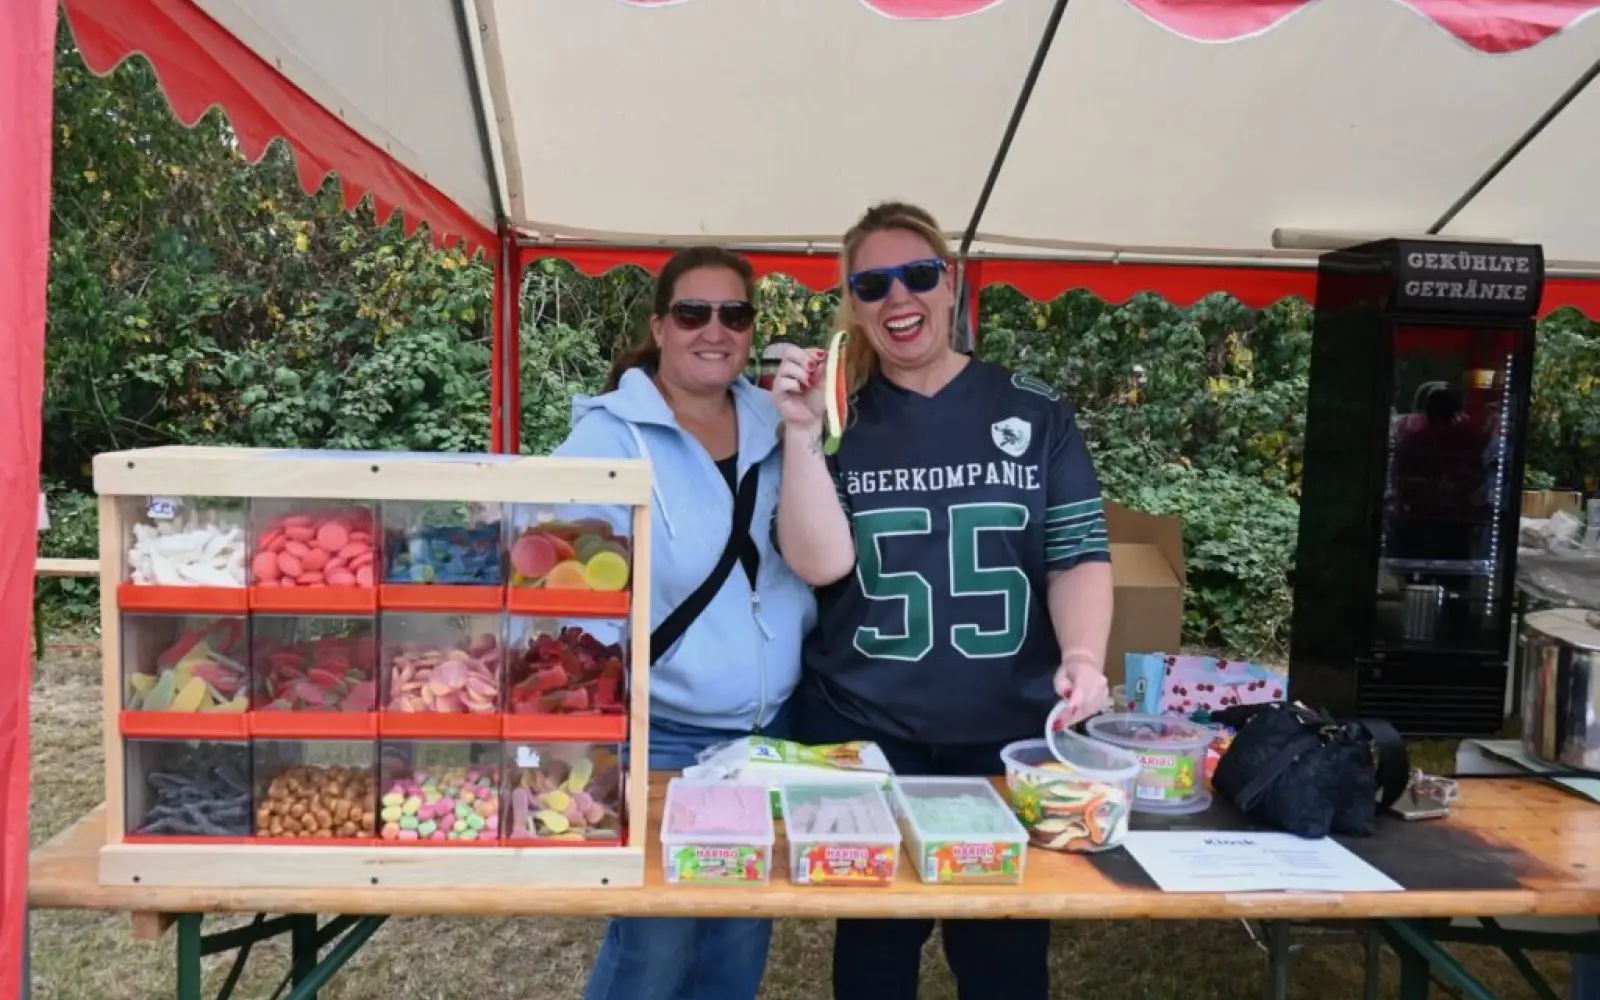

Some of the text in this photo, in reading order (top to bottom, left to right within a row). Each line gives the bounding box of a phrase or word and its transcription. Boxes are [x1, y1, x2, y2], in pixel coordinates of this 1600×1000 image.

[1408, 251, 1530, 273] GEKÜHLTE
[1405, 279, 1528, 300] GETRÄNKE
[845, 460, 1041, 494] äGERKOMPANIE
[853, 502, 1029, 662] 55
